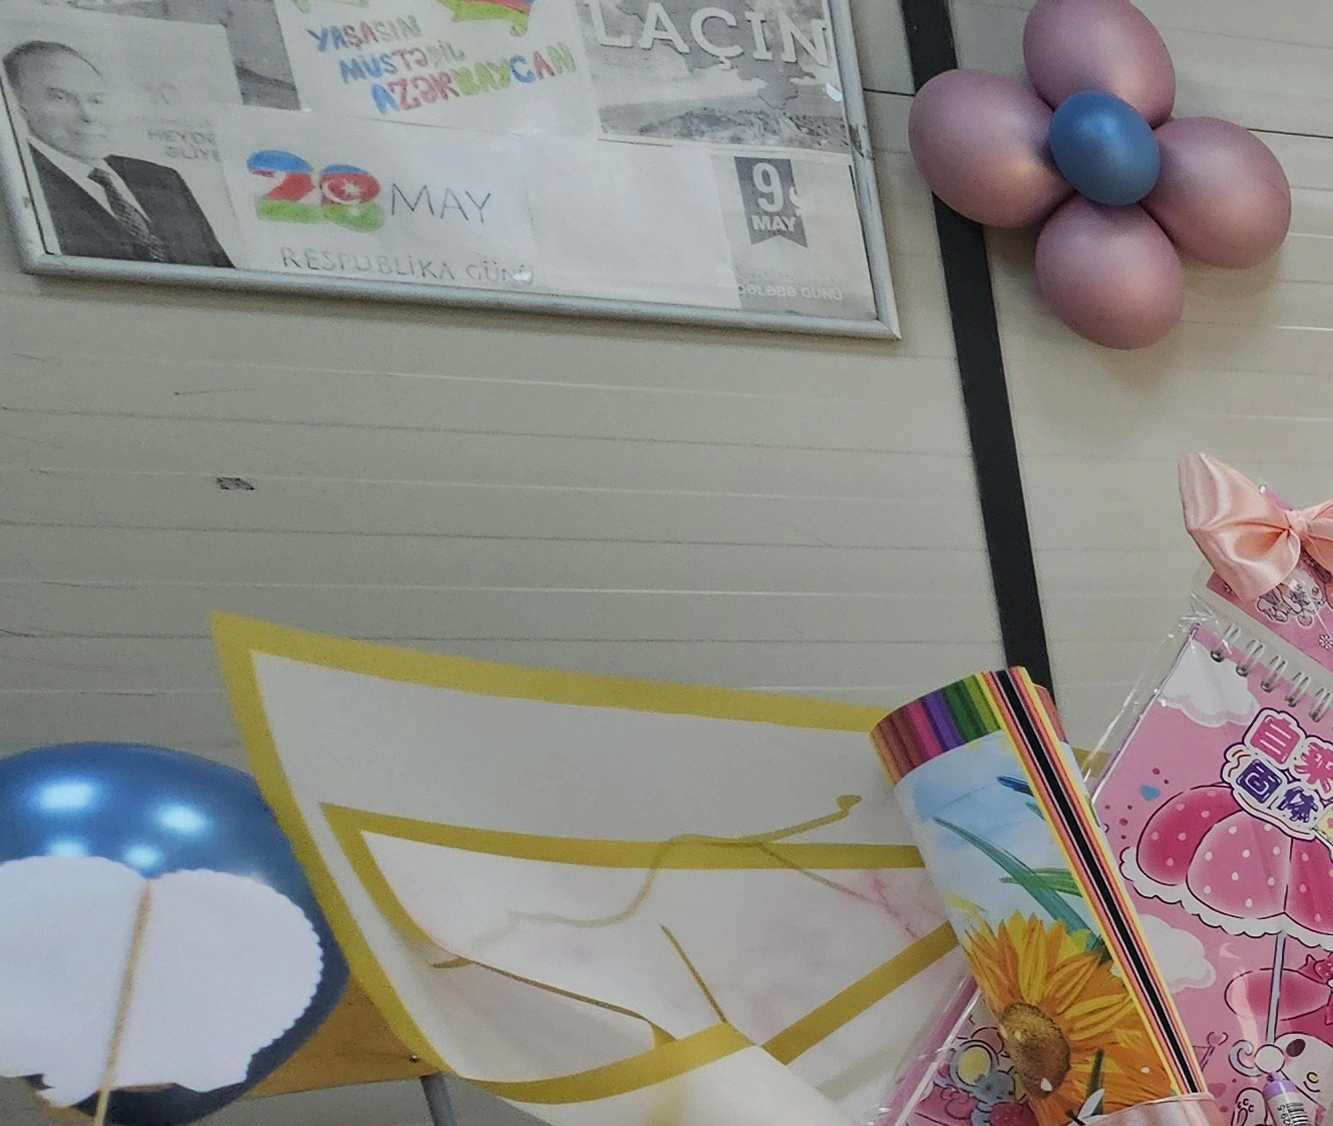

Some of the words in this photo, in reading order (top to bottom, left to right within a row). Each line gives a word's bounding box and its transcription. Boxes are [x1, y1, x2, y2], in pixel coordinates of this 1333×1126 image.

[370, 42, 577, 114] AZƏRBAYCAN
[247, 150, 385, 232] 28
[391, 182, 491, 223] MAY
[752, 162, 784, 213] 9
[751, 214, 797, 232] MAY
